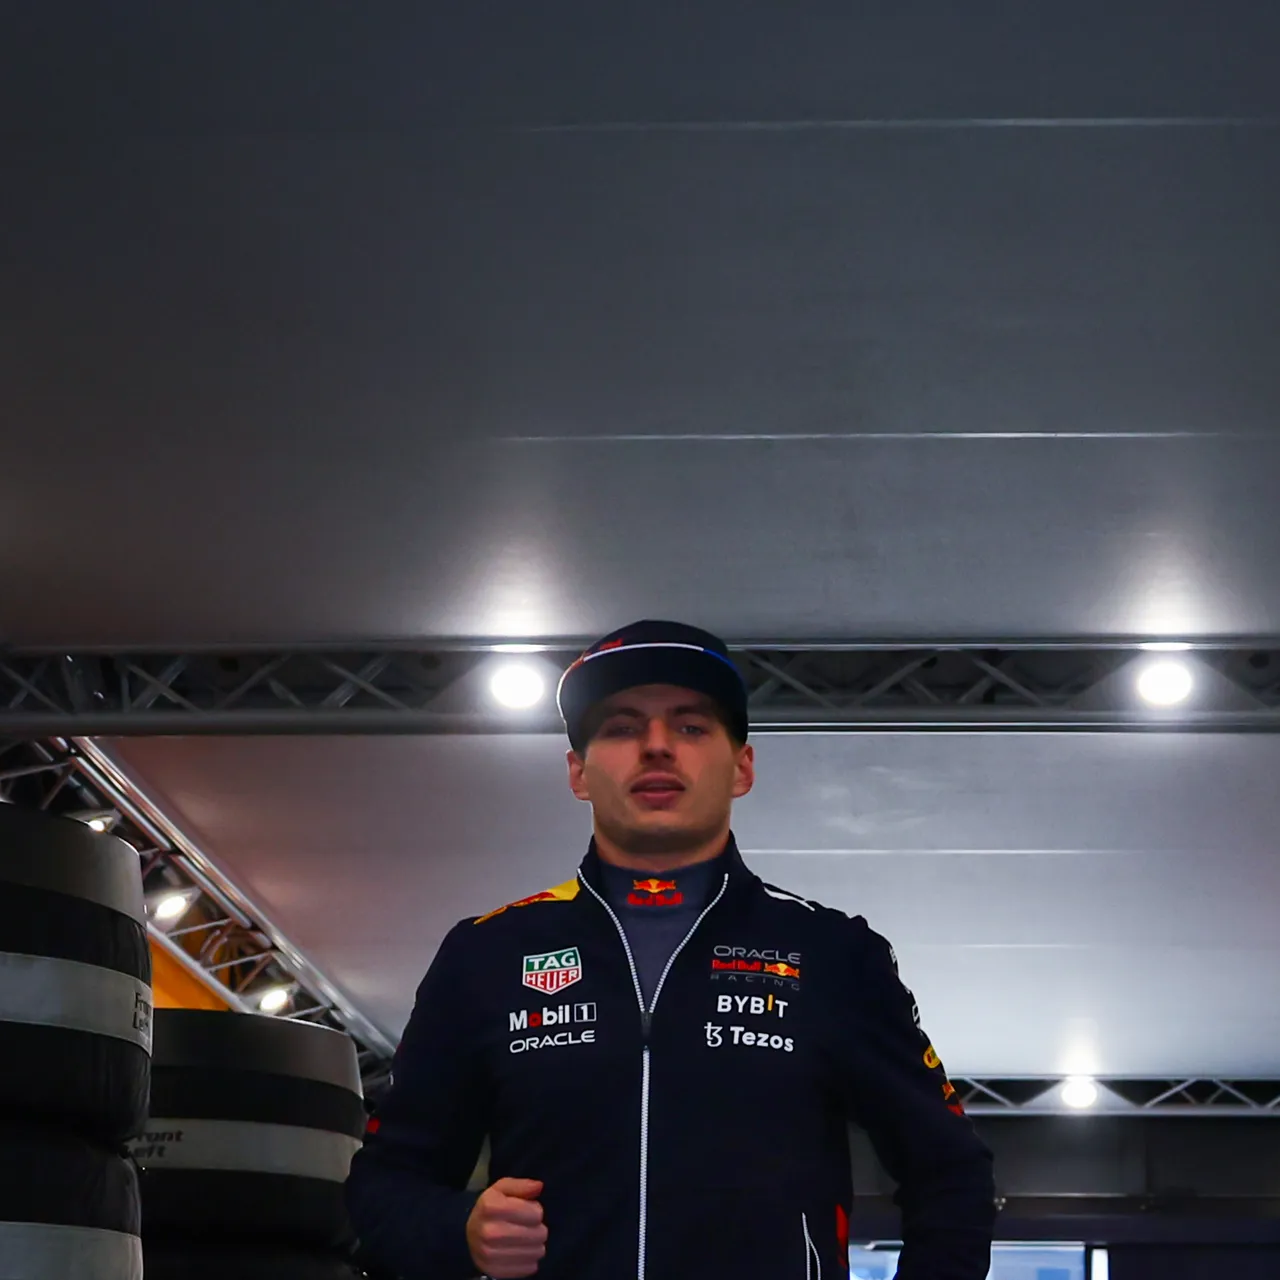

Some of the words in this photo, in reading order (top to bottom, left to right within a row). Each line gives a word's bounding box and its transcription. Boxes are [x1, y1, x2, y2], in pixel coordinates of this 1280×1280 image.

[528, 951, 577, 971] TAG
[713, 945, 802, 965] ORACLE
[526, 969, 579, 992] HEUER
[710, 974, 801, 992] RACING
[508, 1004, 571, 1032] Mobil
[717, 993, 789, 1019] BYBIT
[509, 1029, 596, 1054] ORACLE
[729, 1025, 795, 1053] Tezos
